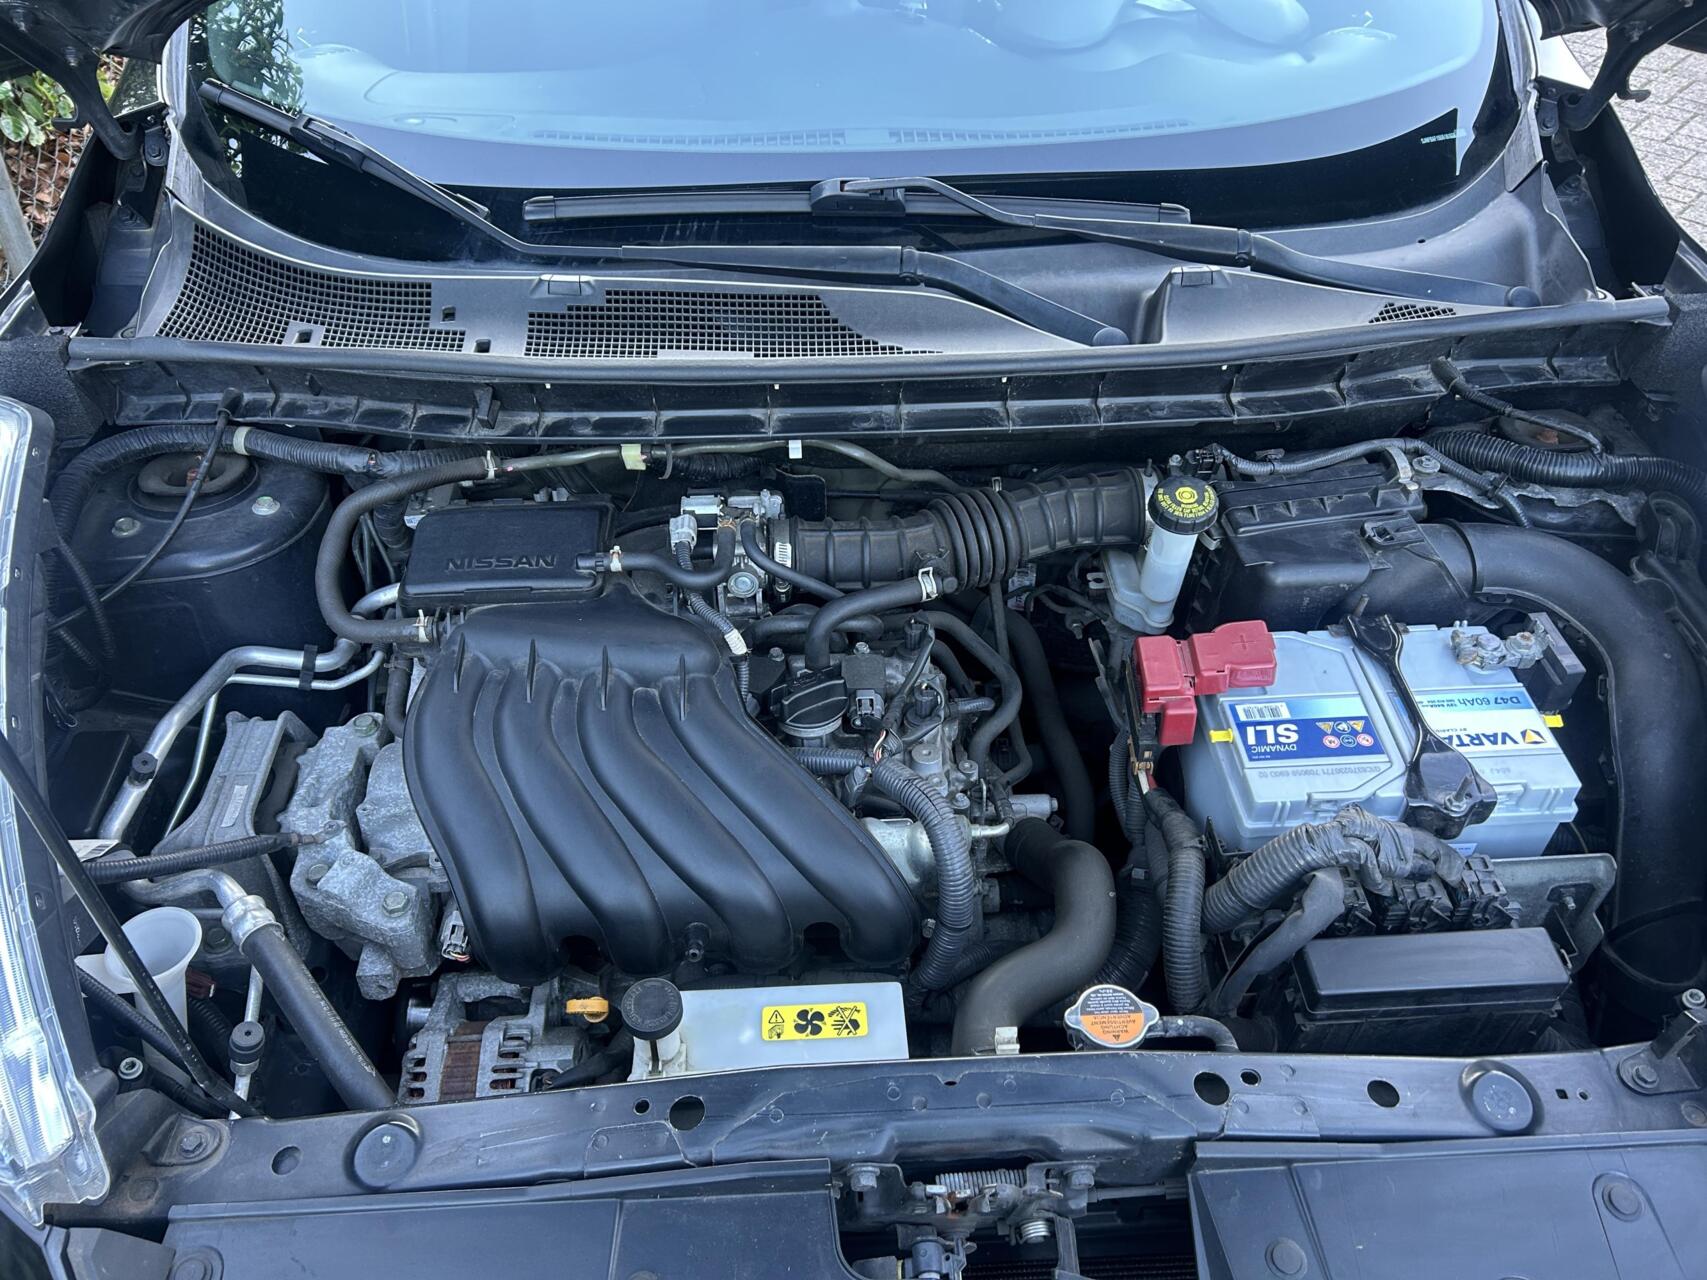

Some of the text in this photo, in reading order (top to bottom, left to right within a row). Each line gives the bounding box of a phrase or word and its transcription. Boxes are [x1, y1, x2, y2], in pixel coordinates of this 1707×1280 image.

[445, 553, 557, 573] NISSAN
[1457, 696, 1490, 706] 60Ah
[1494, 695, 1521, 705] D47
[1245, 723, 1299, 746] SLI
[1250, 743, 1297, 754] DYNAMIC
